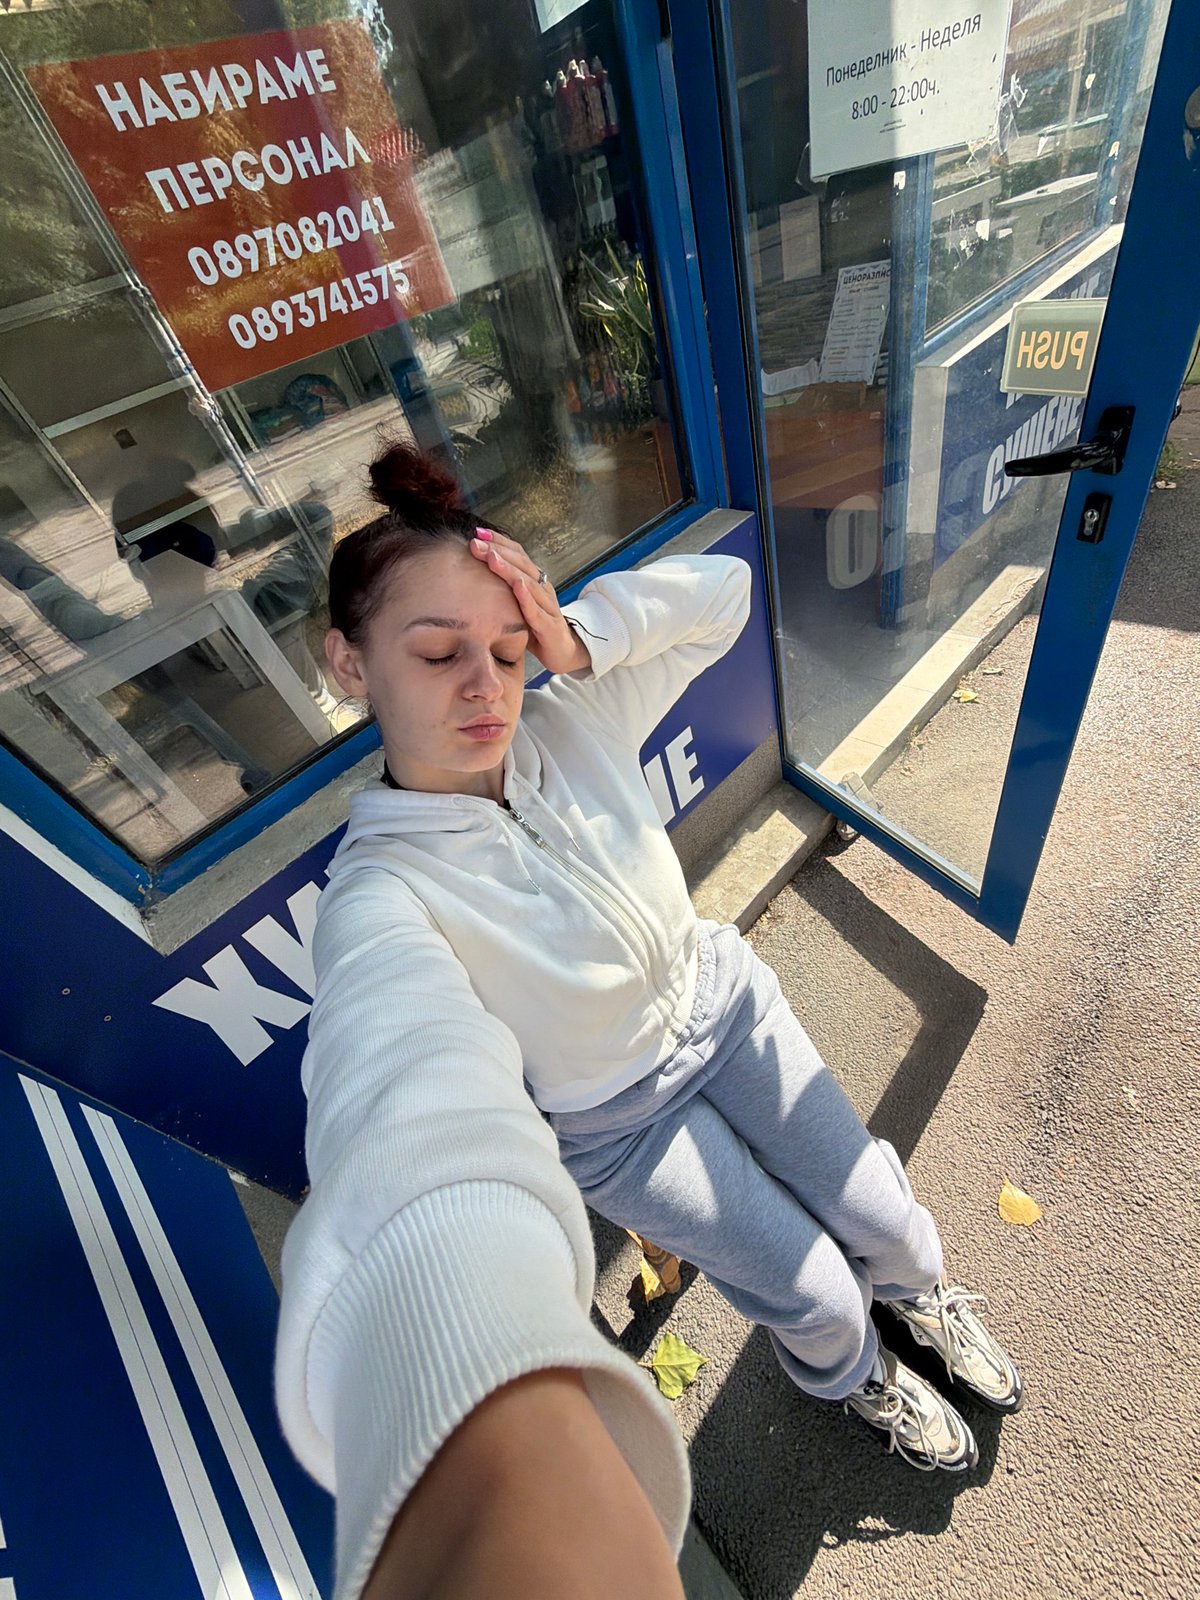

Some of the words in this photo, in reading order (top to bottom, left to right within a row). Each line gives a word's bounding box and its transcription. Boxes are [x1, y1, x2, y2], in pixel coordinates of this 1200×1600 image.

[95, 48, 337, 132] НАБИРАМЕ
[826, 42, 907, 87] Понеделник
[920, 13, 982, 52] Неделя
[851, 94, 878, 120] 8:00
[889, 77, 940, 109] 22:00ч.
[145, 126, 371, 213] ПЕРСОНАЛ
[187, 196, 395, 286] 0897082041
[228, 262, 411, 350] 0893741575
